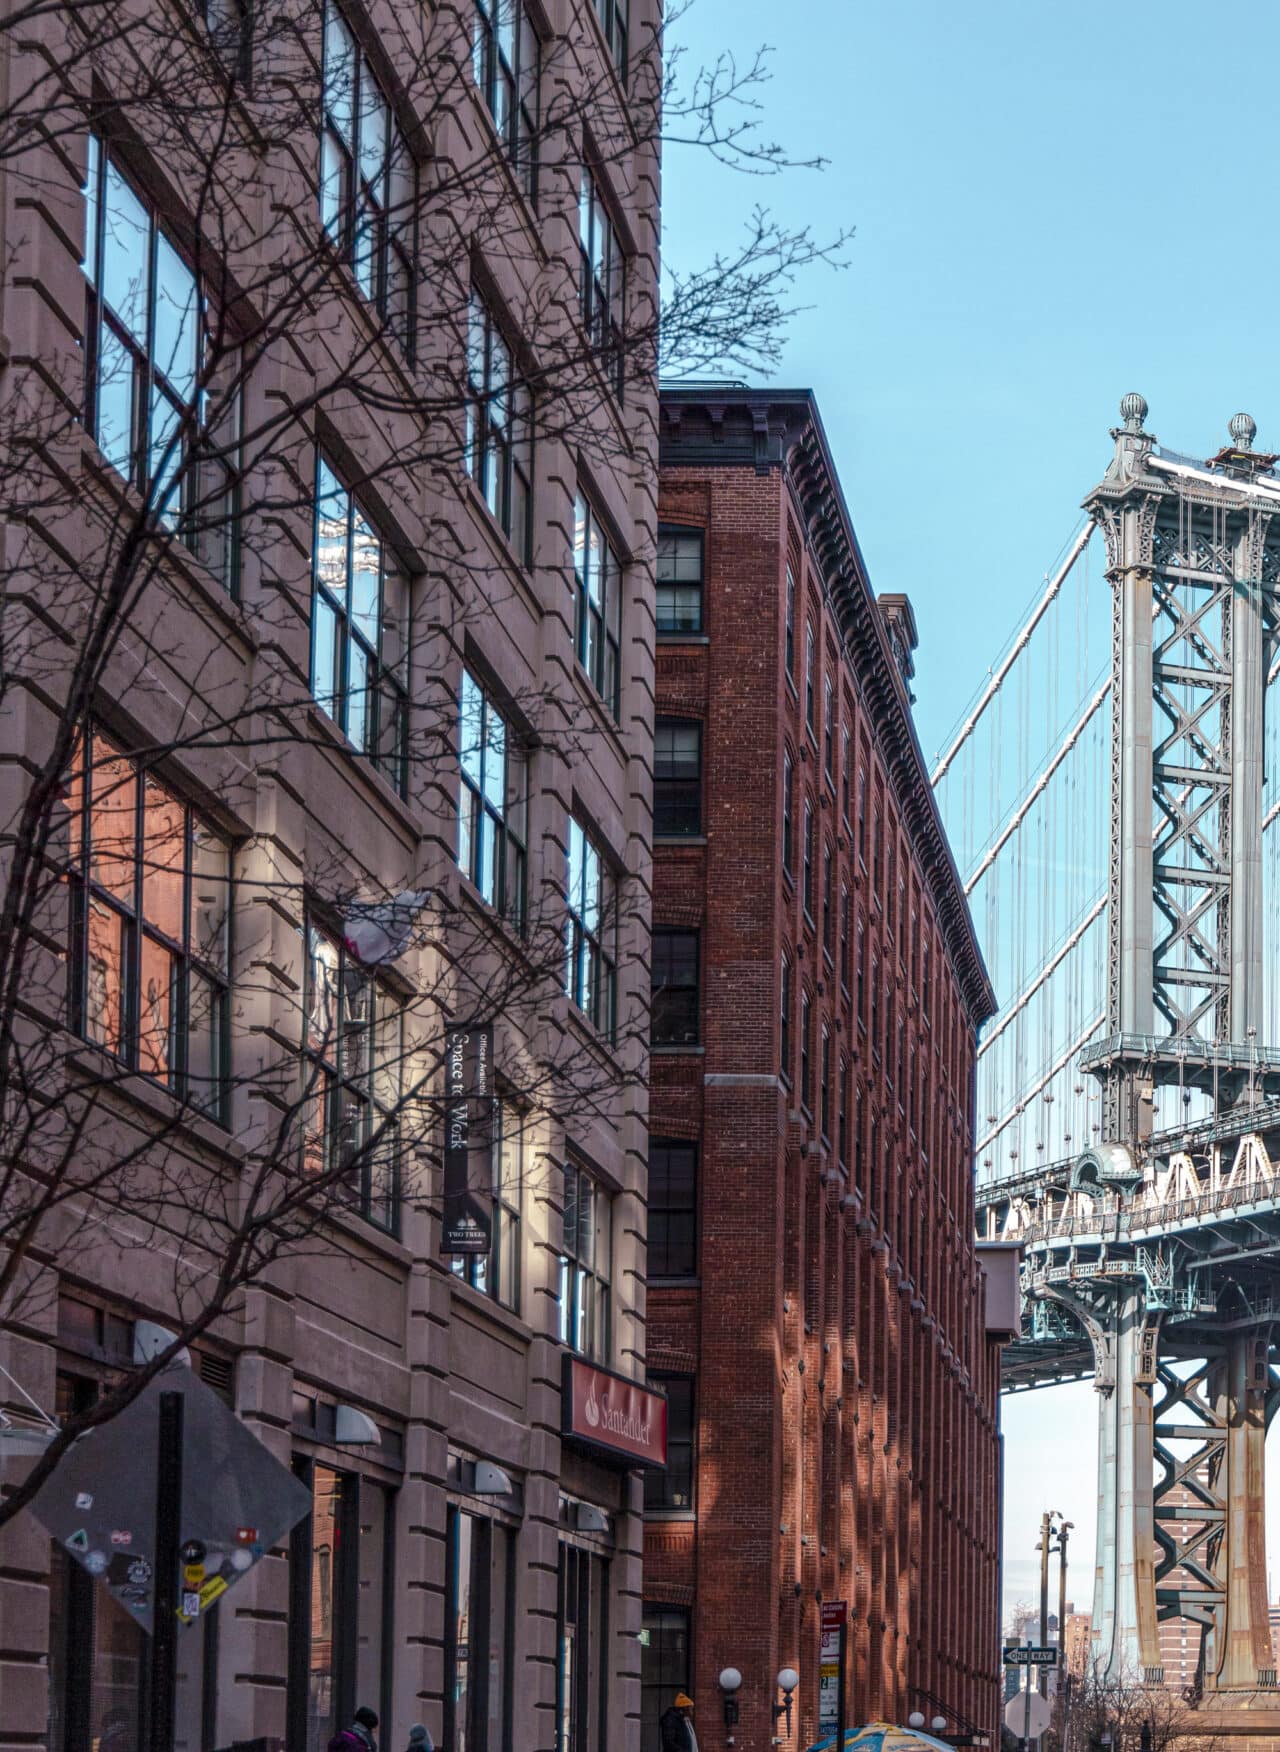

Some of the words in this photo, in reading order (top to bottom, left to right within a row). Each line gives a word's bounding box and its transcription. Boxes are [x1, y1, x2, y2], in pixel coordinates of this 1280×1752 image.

[449, 1033, 470, 1080] Space
[479, 1033, 488, 1061] Offices
[452, 1103, 469, 1150] Work
[601, 1393, 651, 1445] Santander
[1010, 1652, 1026, 1660] ONE
[1033, 1652, 1049, 1660] WAY
